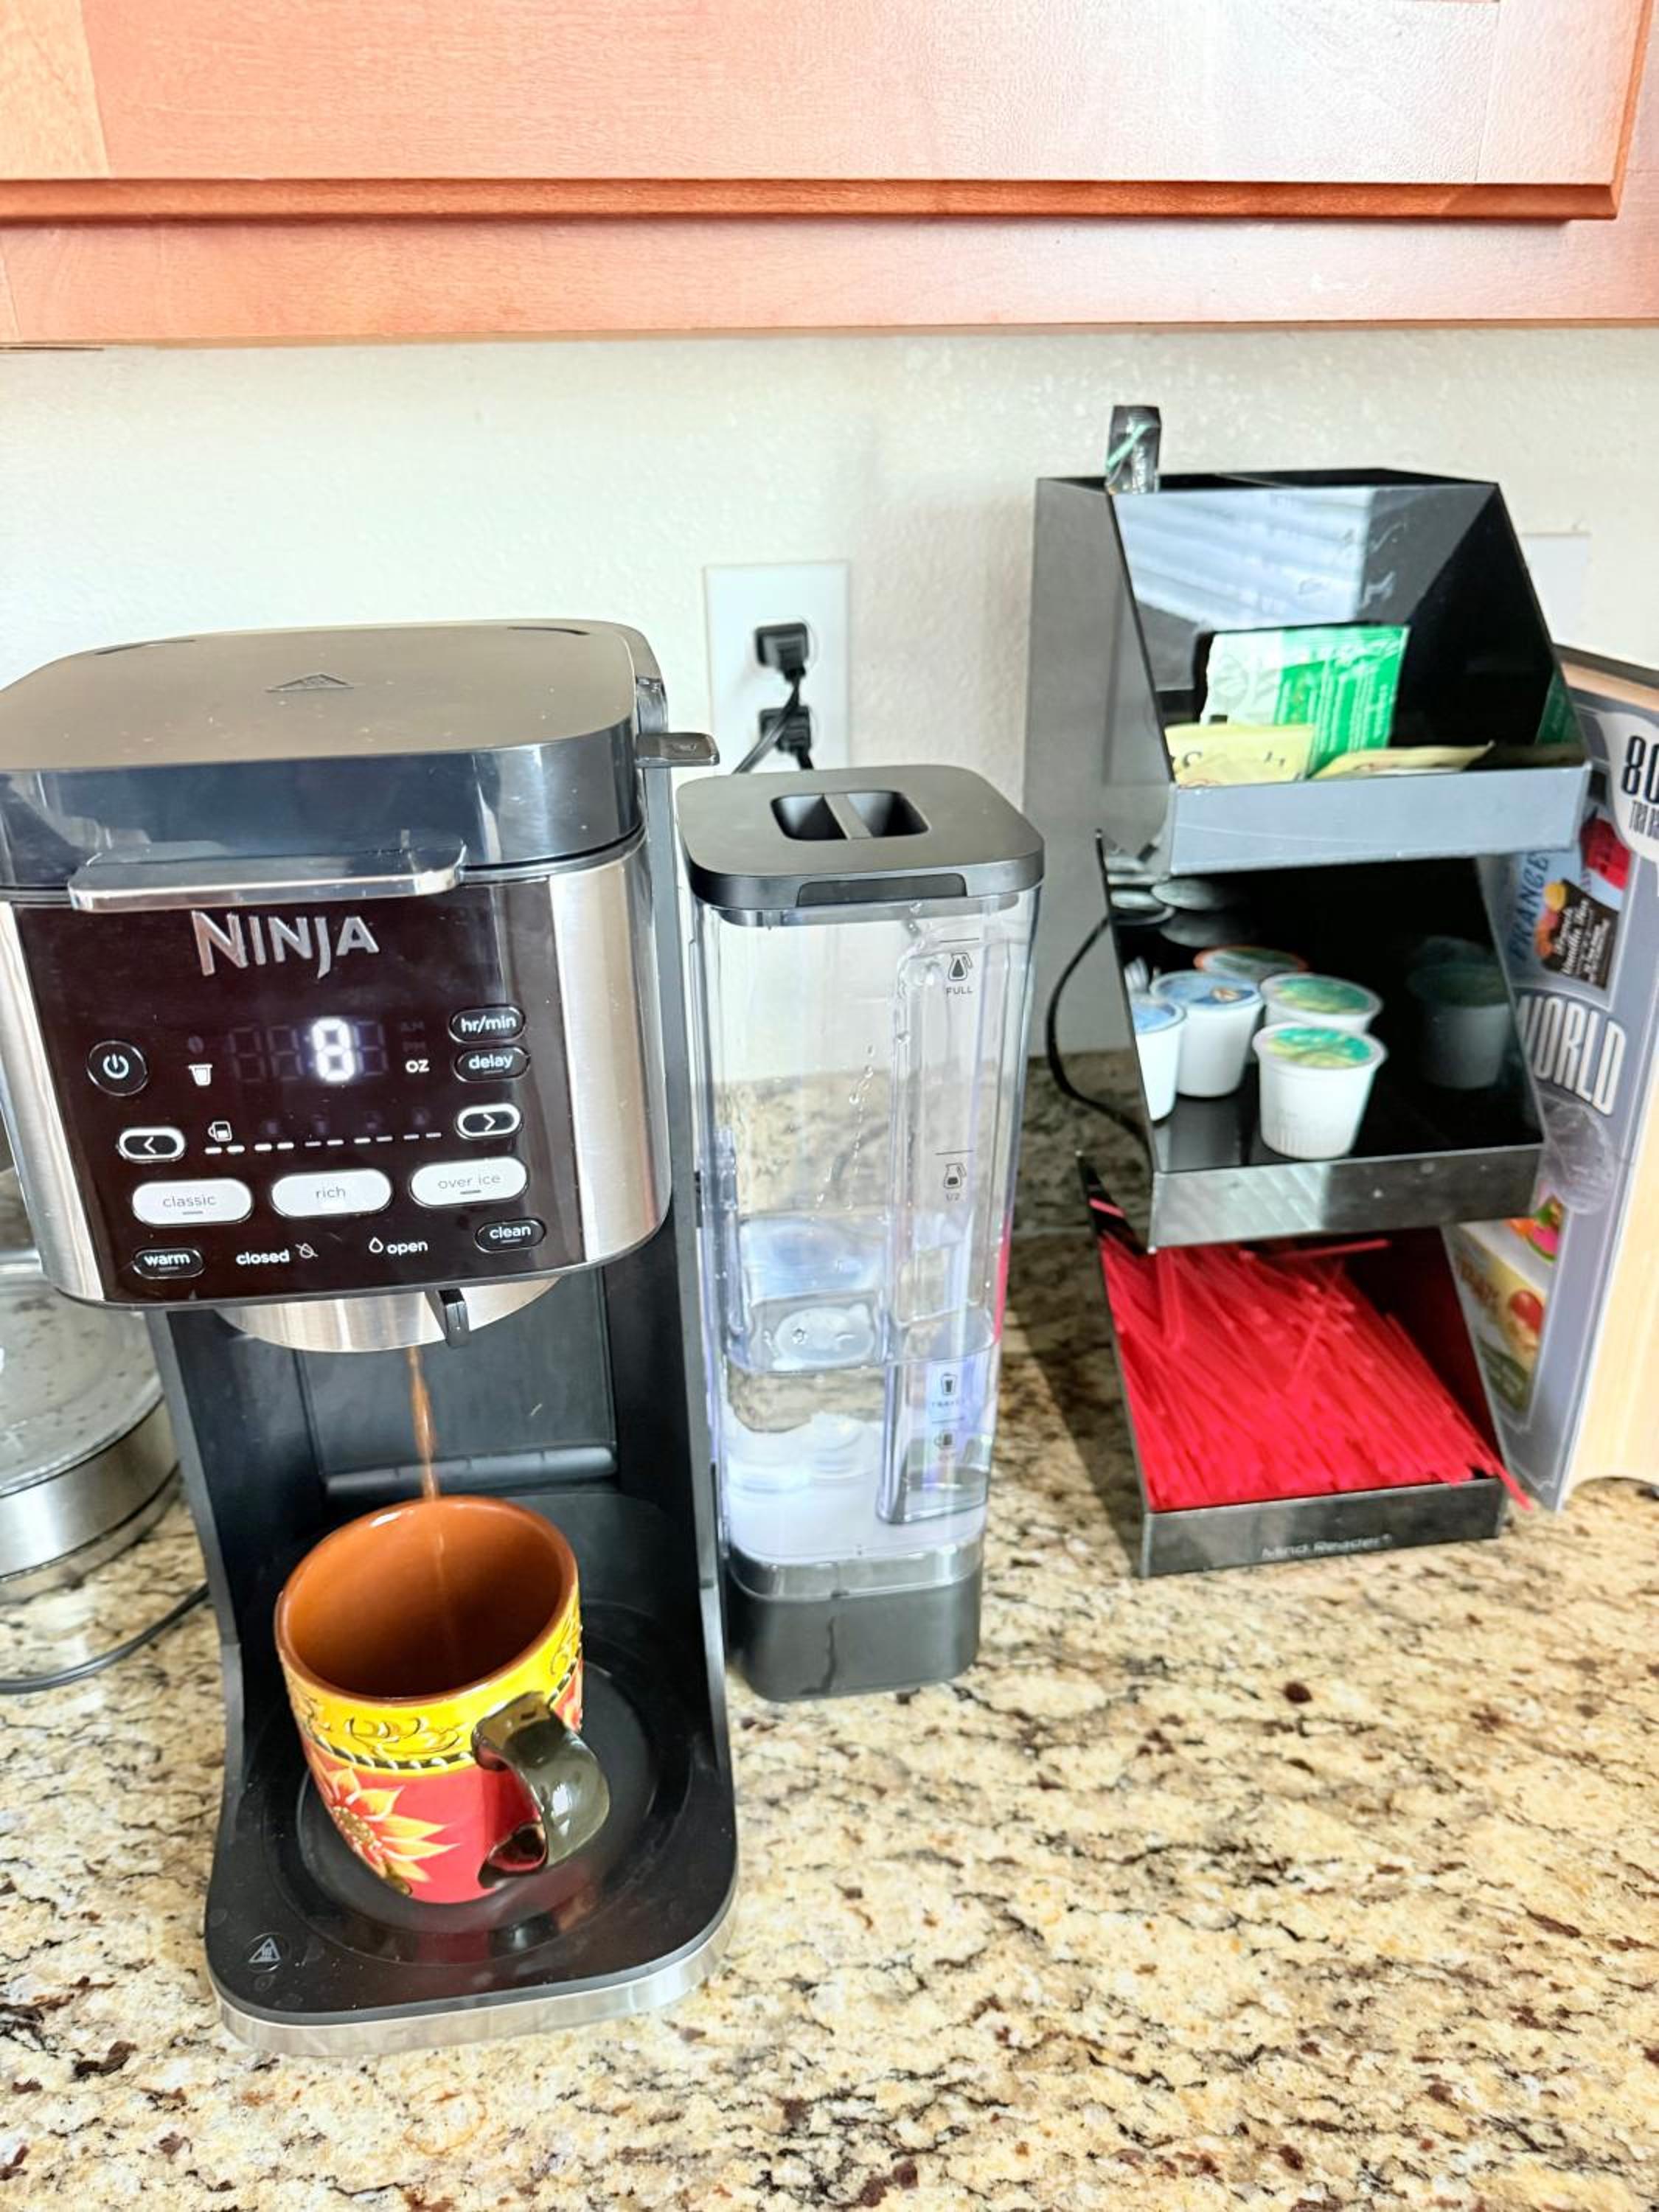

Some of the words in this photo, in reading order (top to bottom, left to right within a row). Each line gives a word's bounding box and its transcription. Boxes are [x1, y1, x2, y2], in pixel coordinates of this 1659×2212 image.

[191, 911, 380, 978] NINJA
[946, 987, 973, 995] FULL
[461, 1014, 516, 1032] hr/min
[311, 1017, 355, 1082] 8
[405, 1059, 429, 1073] oz
[468, 1053, 514, 1071] delay
[438, 1175, 473, 1190] over
[474, 1172, 501, 1186] ice
[315, 1184, 347, 1200] rich
[162, 1193, 216, 1208] classic
[490, 1224, 531, 1239] clean
[387, 1240, 428, 1256] open
[145, 1253, 190, 1267] warm
[236, 1249, 290, 1265] closed
